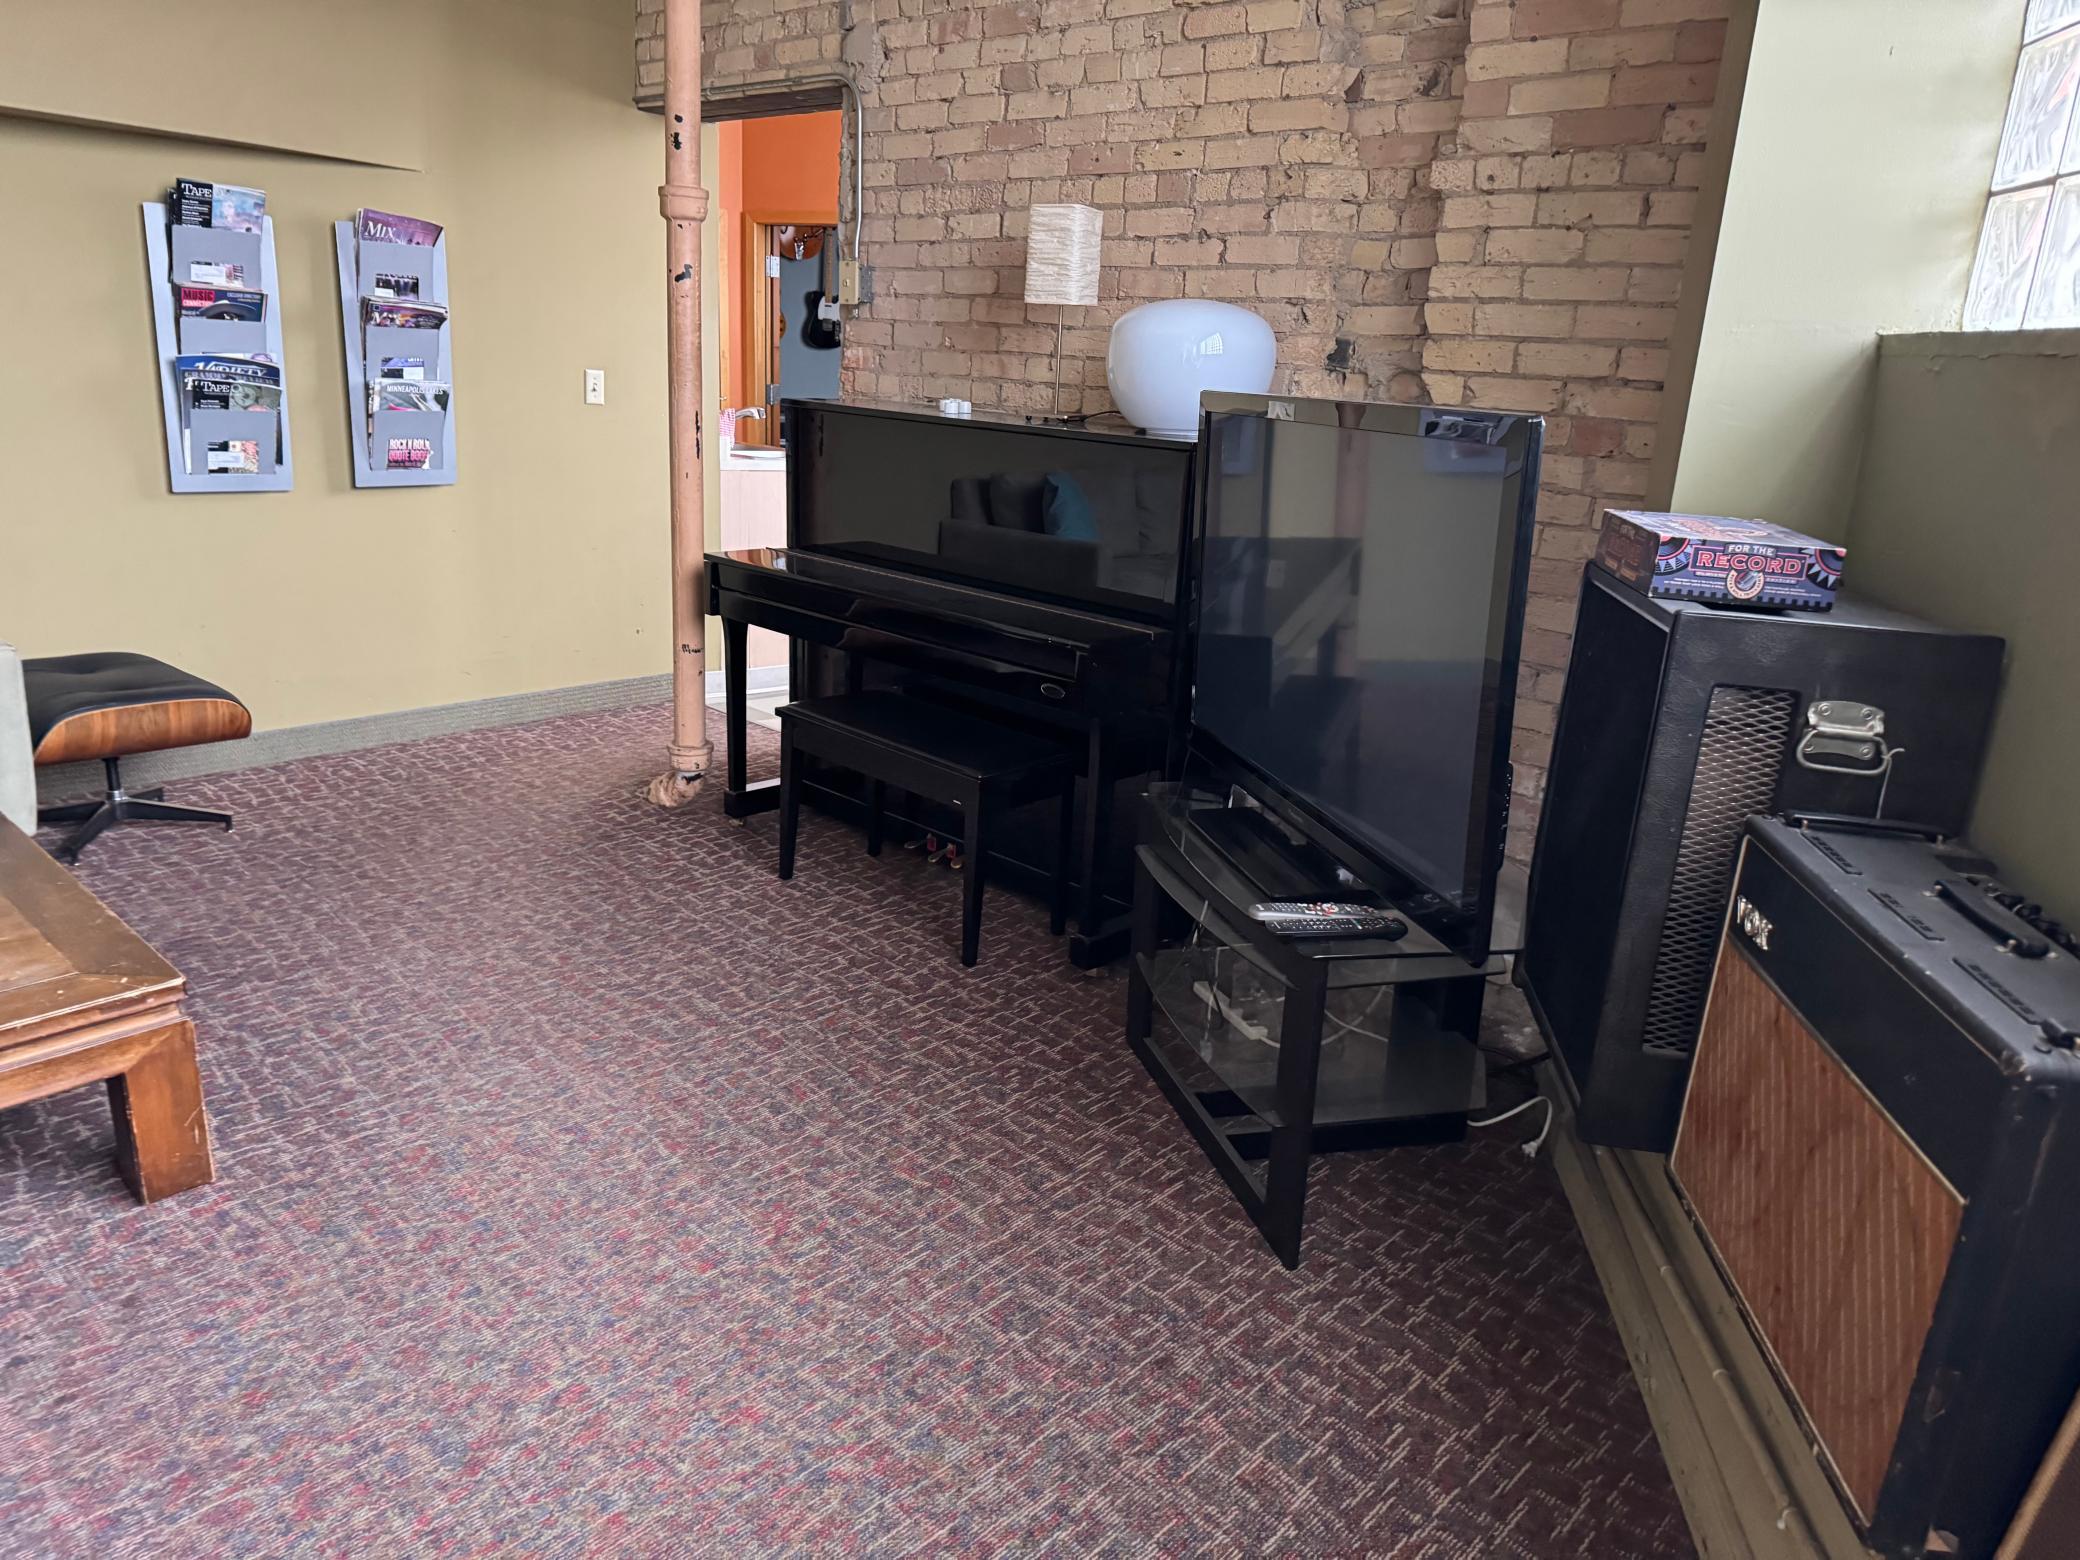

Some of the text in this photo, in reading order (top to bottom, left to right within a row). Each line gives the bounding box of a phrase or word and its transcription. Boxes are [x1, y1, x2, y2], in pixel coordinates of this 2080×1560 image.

[181, 183, 212, 198] TAPE
[364, 220, 396, 240] MIX
[183, 289, 214, 301] MUSIC
[200, 381, 230, 393] TAPE
[386, 384, 424, 394] MINNEAPOLIS
[389, 438, 407, 450] ROCK
[1728, 544, 1775, 556] FOR THE
[1696, 550, 1802, 575] RECORD
